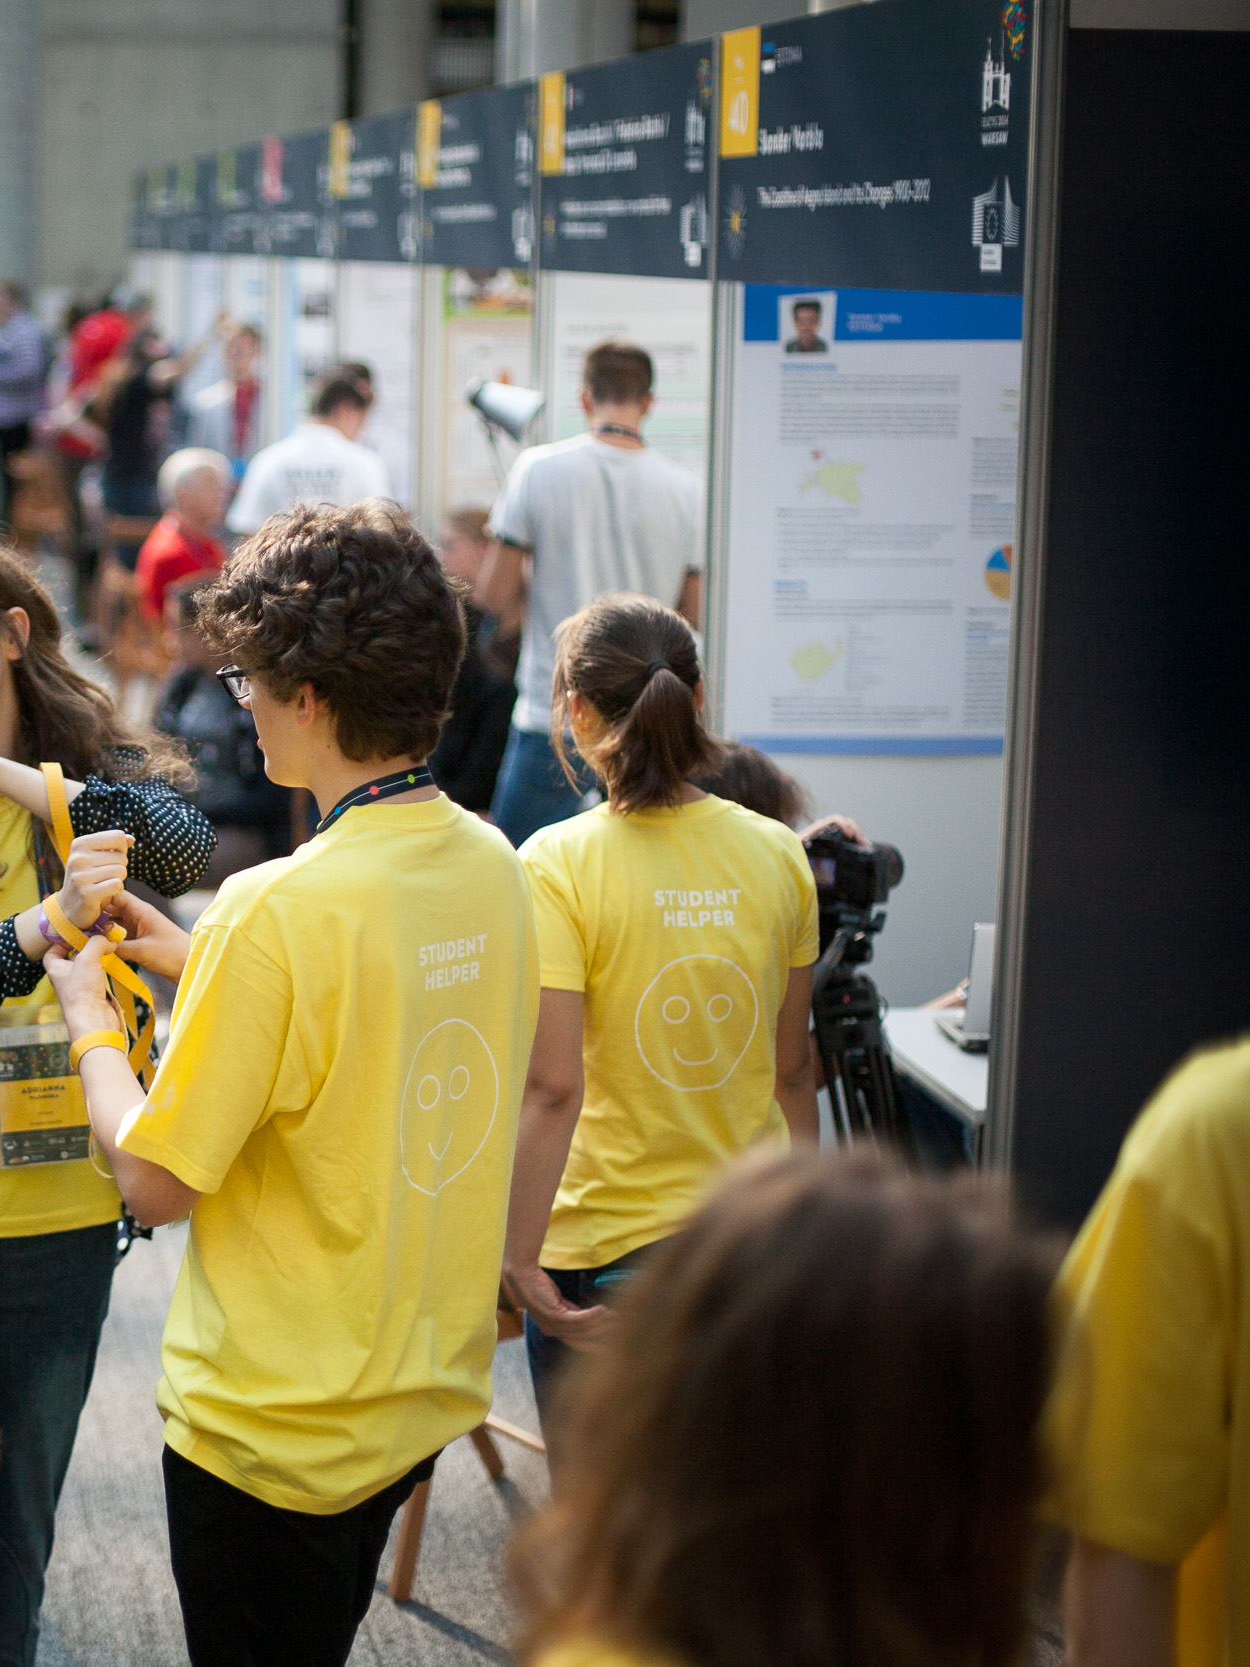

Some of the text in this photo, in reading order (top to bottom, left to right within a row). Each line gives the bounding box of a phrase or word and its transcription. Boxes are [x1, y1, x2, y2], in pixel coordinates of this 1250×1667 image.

[727, 89, 749, 137] 40
[653, 889, 742, 907] STUDENT
[663, 910, 736, 928] HELPER
[419, 933, 488, 967] STUDENT
[425, 961, 480, 991] HELPER
